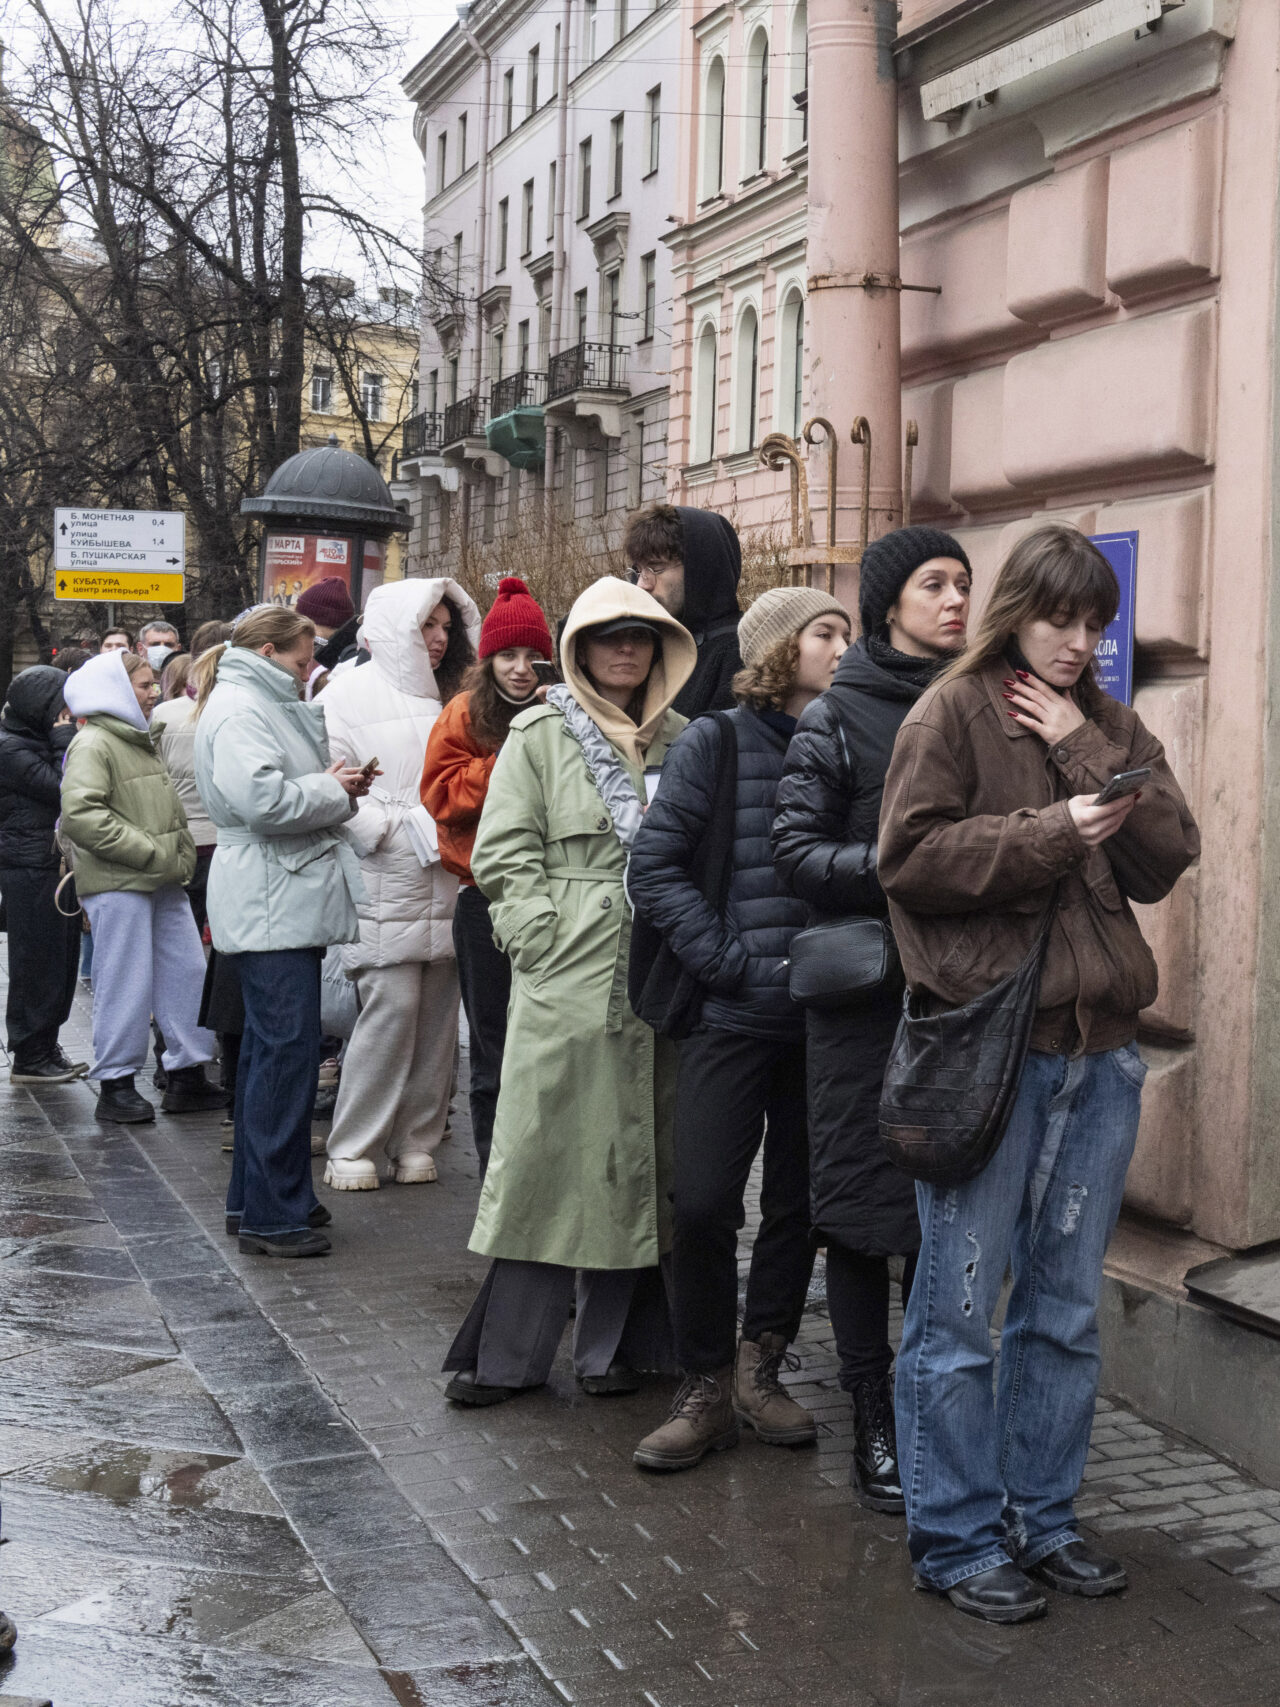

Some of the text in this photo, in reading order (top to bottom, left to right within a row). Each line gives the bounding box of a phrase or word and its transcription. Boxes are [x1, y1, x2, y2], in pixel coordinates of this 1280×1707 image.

[82, 513, 135, 521] МОНЕТНАЯ
[152, 519, 164, 527] 0,4
[71, 538, 131, 547] КУЙБЫШЕВА
[275, 540, 301, 550] МАРТА
[82, 552, 146, 560] ПУШКАРСКАЯ
[73, 578, 120, 586] КУБАТУРА
[102, 588, 149, 596] интерьера
